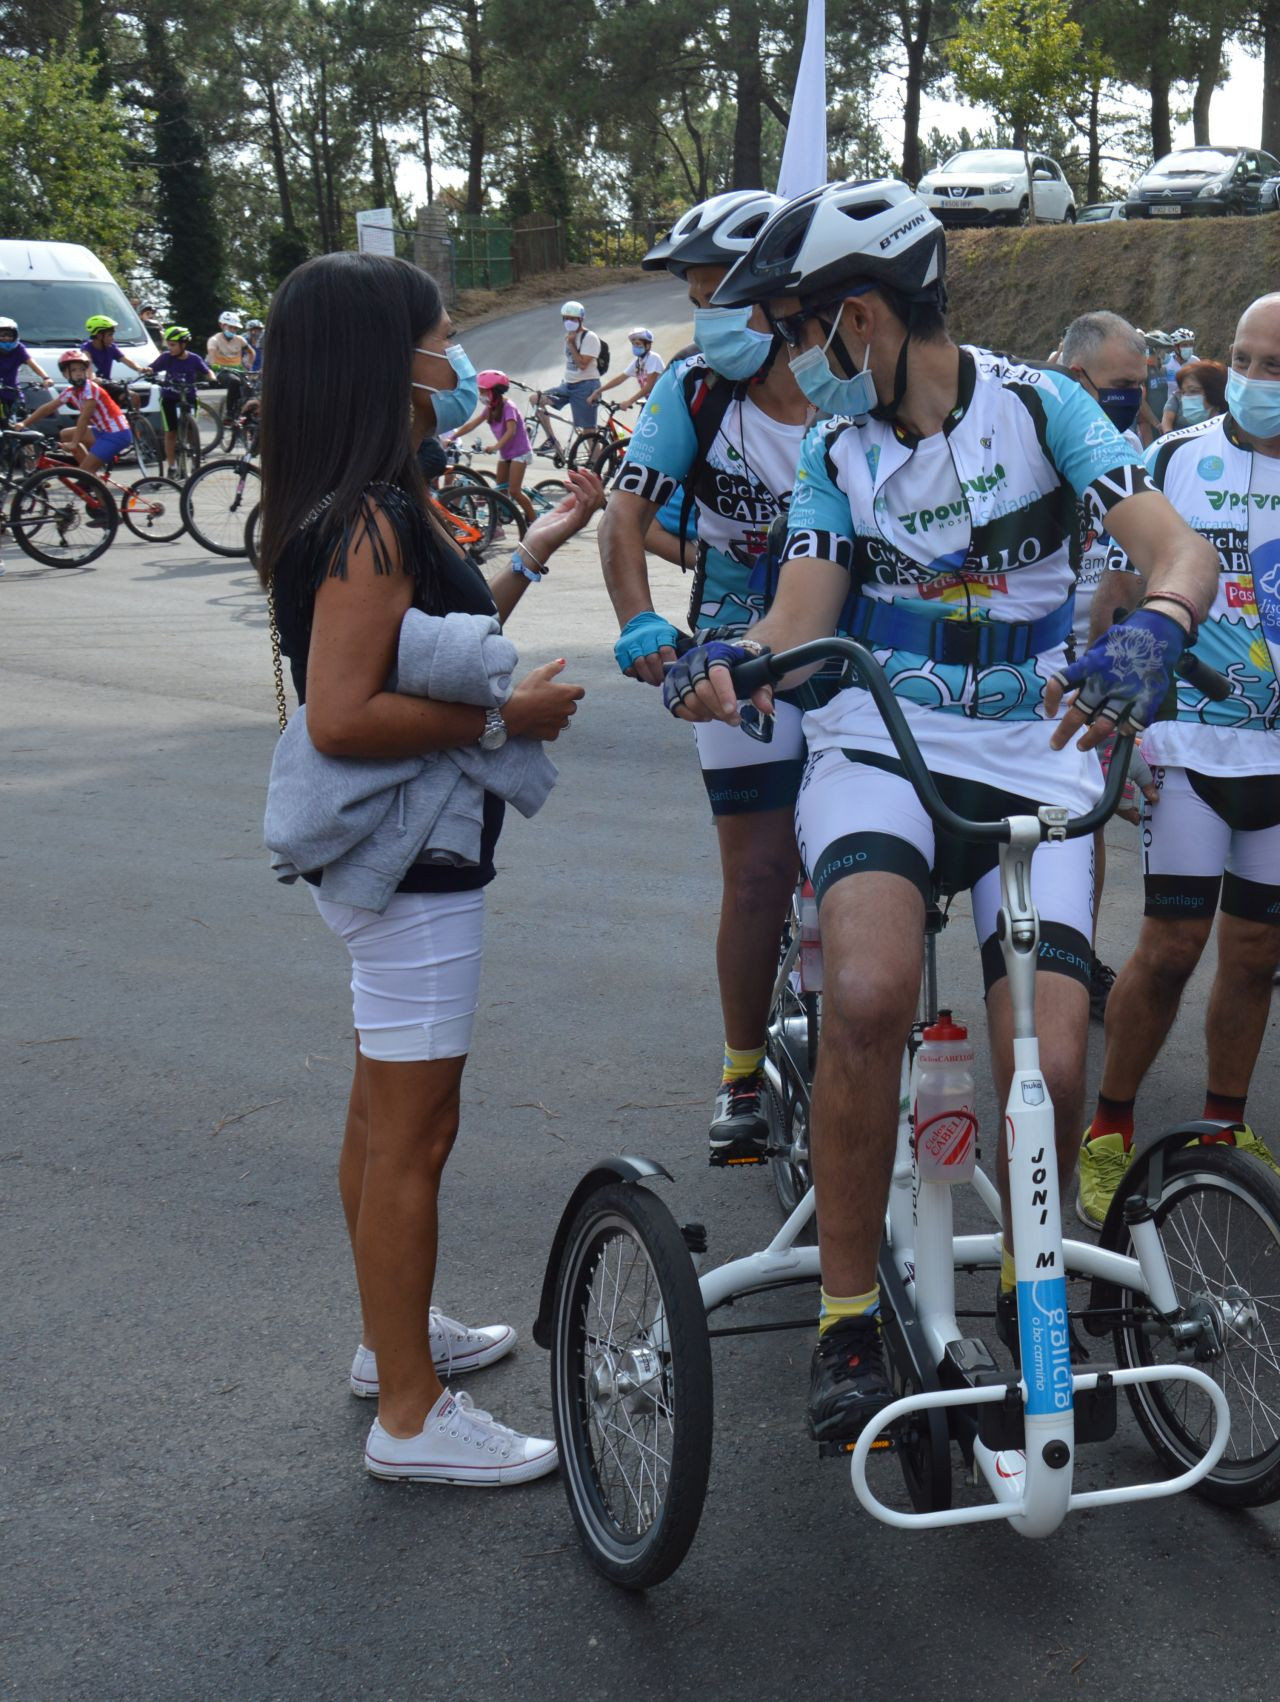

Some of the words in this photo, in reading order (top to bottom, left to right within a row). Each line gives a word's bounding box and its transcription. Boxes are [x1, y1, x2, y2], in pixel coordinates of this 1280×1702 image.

[925, 1124, 947, 1150] Ciclos
[1031, 1147, 1048, 1225] JONI
[1036, 1251, 1055, 1269] M
[1048, 1308, 1071, 1409] galicia
